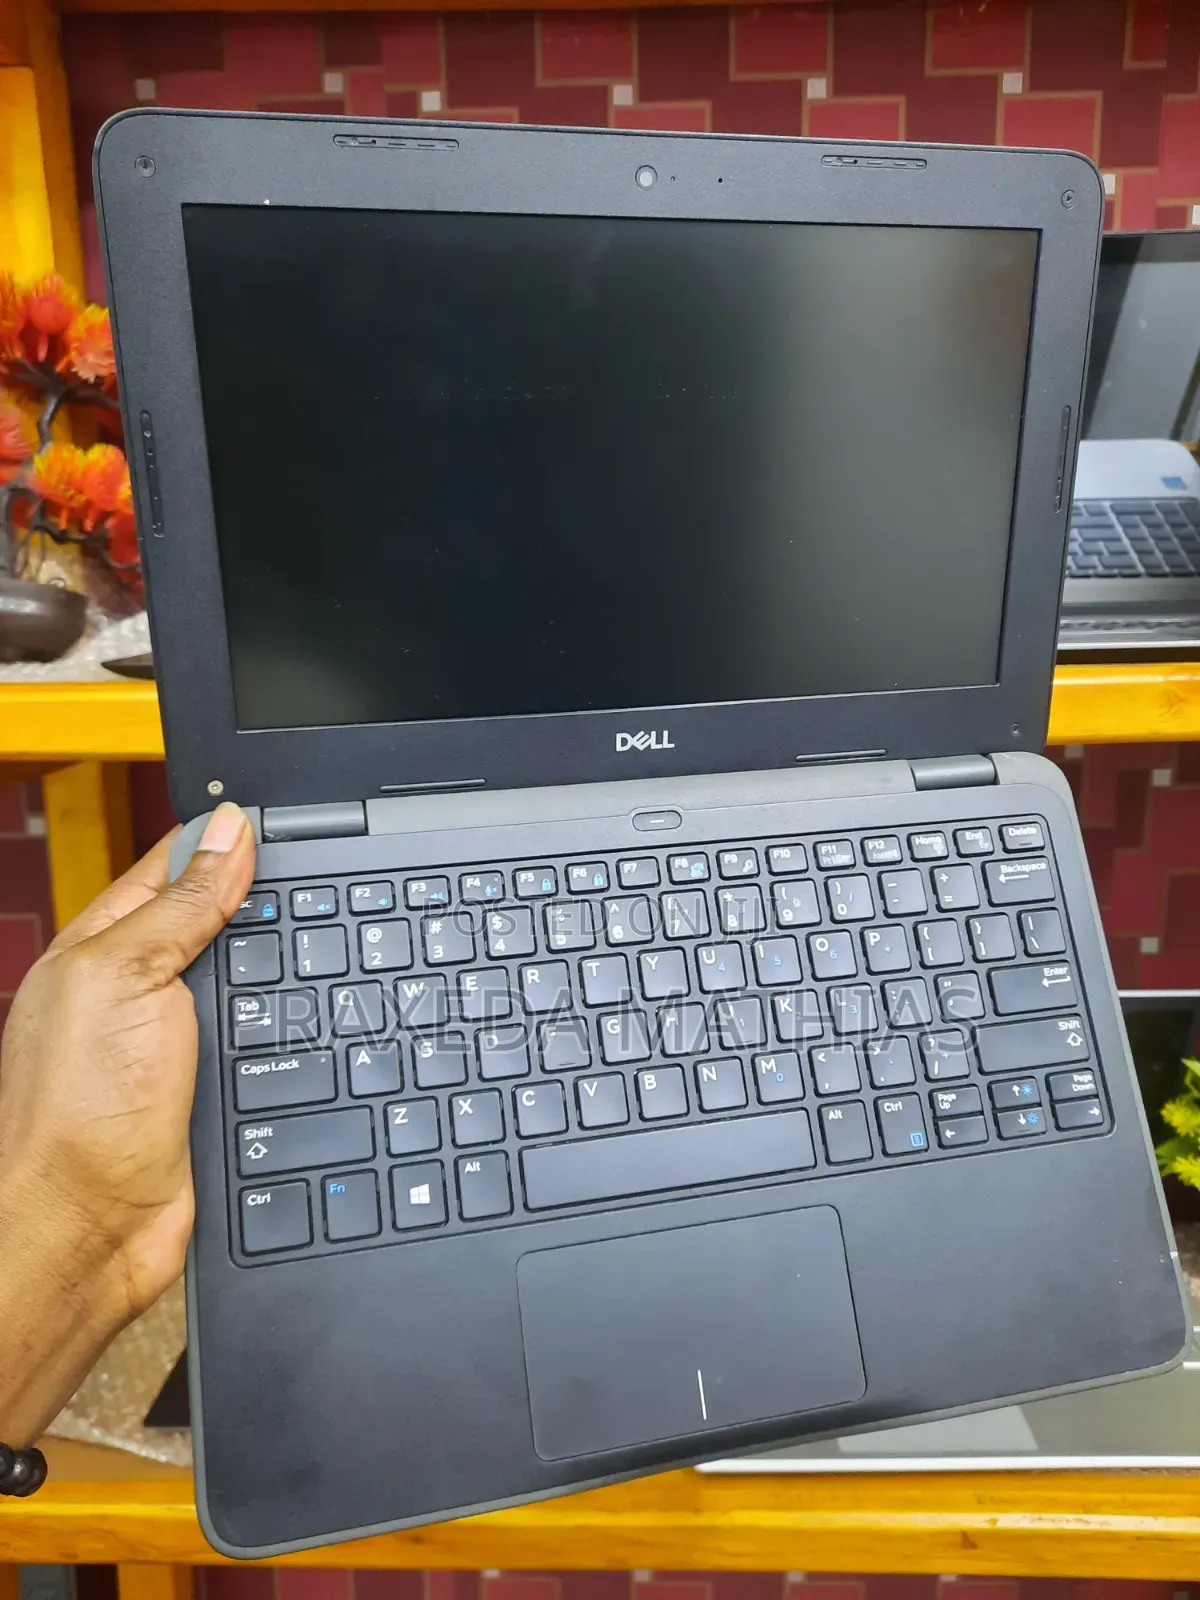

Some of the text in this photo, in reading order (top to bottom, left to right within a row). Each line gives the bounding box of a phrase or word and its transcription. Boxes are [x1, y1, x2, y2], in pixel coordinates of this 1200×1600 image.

[616, 730, 675, 752] DELL
[965, 831, 983, 841] End
[1009, 826, 1037, 836] Delete
[868, 840, 885, 850] F12
[915, 835, 942, 845] Home
[773, 849, 790, 859] F10
[821, 845, 837, 855] F11
[674, 858, 688, 868] F8
[724, 854, 738, 864] F9
[572, 868, 587, 878] F6
[624, 863, 637, 874] F7
[1001, 862, 1047, 874] Backspace
[465, 877, 481, 888] F4
[520, 872, 534, 883] F5
[355, 887, 371, 898] F2
[411, 882, 427, 893] F3
[238, 900, 253, 909] sc
[297, 893, 311, 903] F1
[783, 908, 793, 922] 9
[366, 927, 383, 943] @
[612, 925, 624, 939] 6
[495, 938, 505, 951] 4
[816, 938, 829, 951] O
[869, 933, 881, 946] P
[433, 945, 443, 959] 3
[703, 949, 716, 965] U
[758, 945, 765, 958] I
[371, 952, 382, 966] 2
[646, 956, 659, 970] Y
[303, 960, 311, 972] 1
[587, 962, 600, 977] T
[1044, 966, 1068, 976] Enter
[526, 969, 540, 984] R
[402, 982, 424, 998] W
[465, 977, 478, 991] E
[238, 1001, 260, 1012] Tab
[780, 999, 792, 1013] K
[607, 1019, 621, 1034] G
[1058, 1020, 1081, 1031] Shift
[420, 1042, 433, 1057] S
[356, 1051, 371, 1066] A
[241, 1059, 299, 1076] Caps Lock
[761, 1058, 777, 1074] M
[702, 1066, 717, 1082] N
[1073, 1073, 1092, 1084] Page
[644, 1075, 657, 1090] B
[1072, 1081, 1095, 1092] Down
[583, 1082, 598, 1097] V
[522, 1091, 535, 1106] C
[938, 1092, 956, 1103] Page
[458, 1099, 473, 1115] X
[884, 1101, 902, 1113] Ctrl
[939, 1101, 950, 1111] Up
[394, 1109, 408, 1124] Z
[828, 1110, 843, 1120] Alt
[244, 1127, 273, 1140] Shift
[464, 1162, 481, 1173] Alt
[329, 1183, 345, 1193] Fn
[247, 1192, 271, 1206] Ctrl
